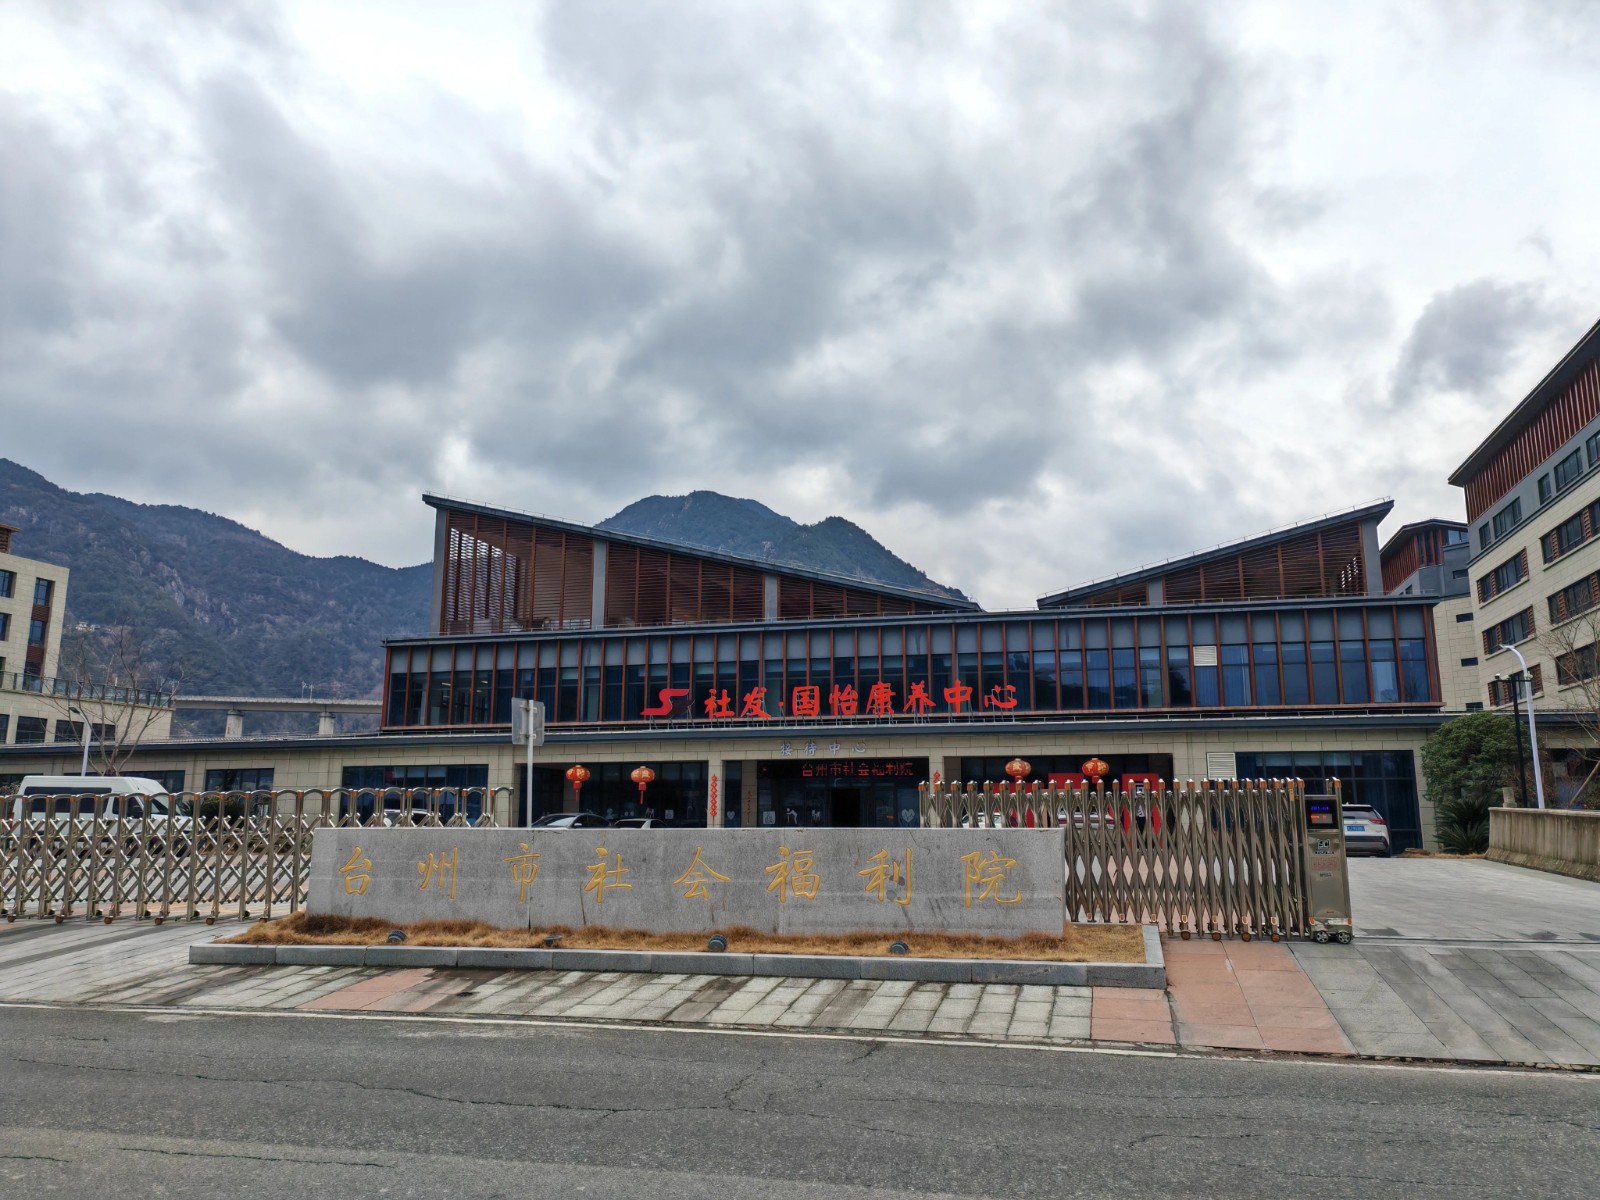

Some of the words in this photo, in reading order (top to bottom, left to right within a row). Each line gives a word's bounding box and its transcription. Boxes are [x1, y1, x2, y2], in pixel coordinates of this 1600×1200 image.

[780, 740, 867, 756] 接待中心
[339, 843, 1023, 907] 台州市社会福利院
